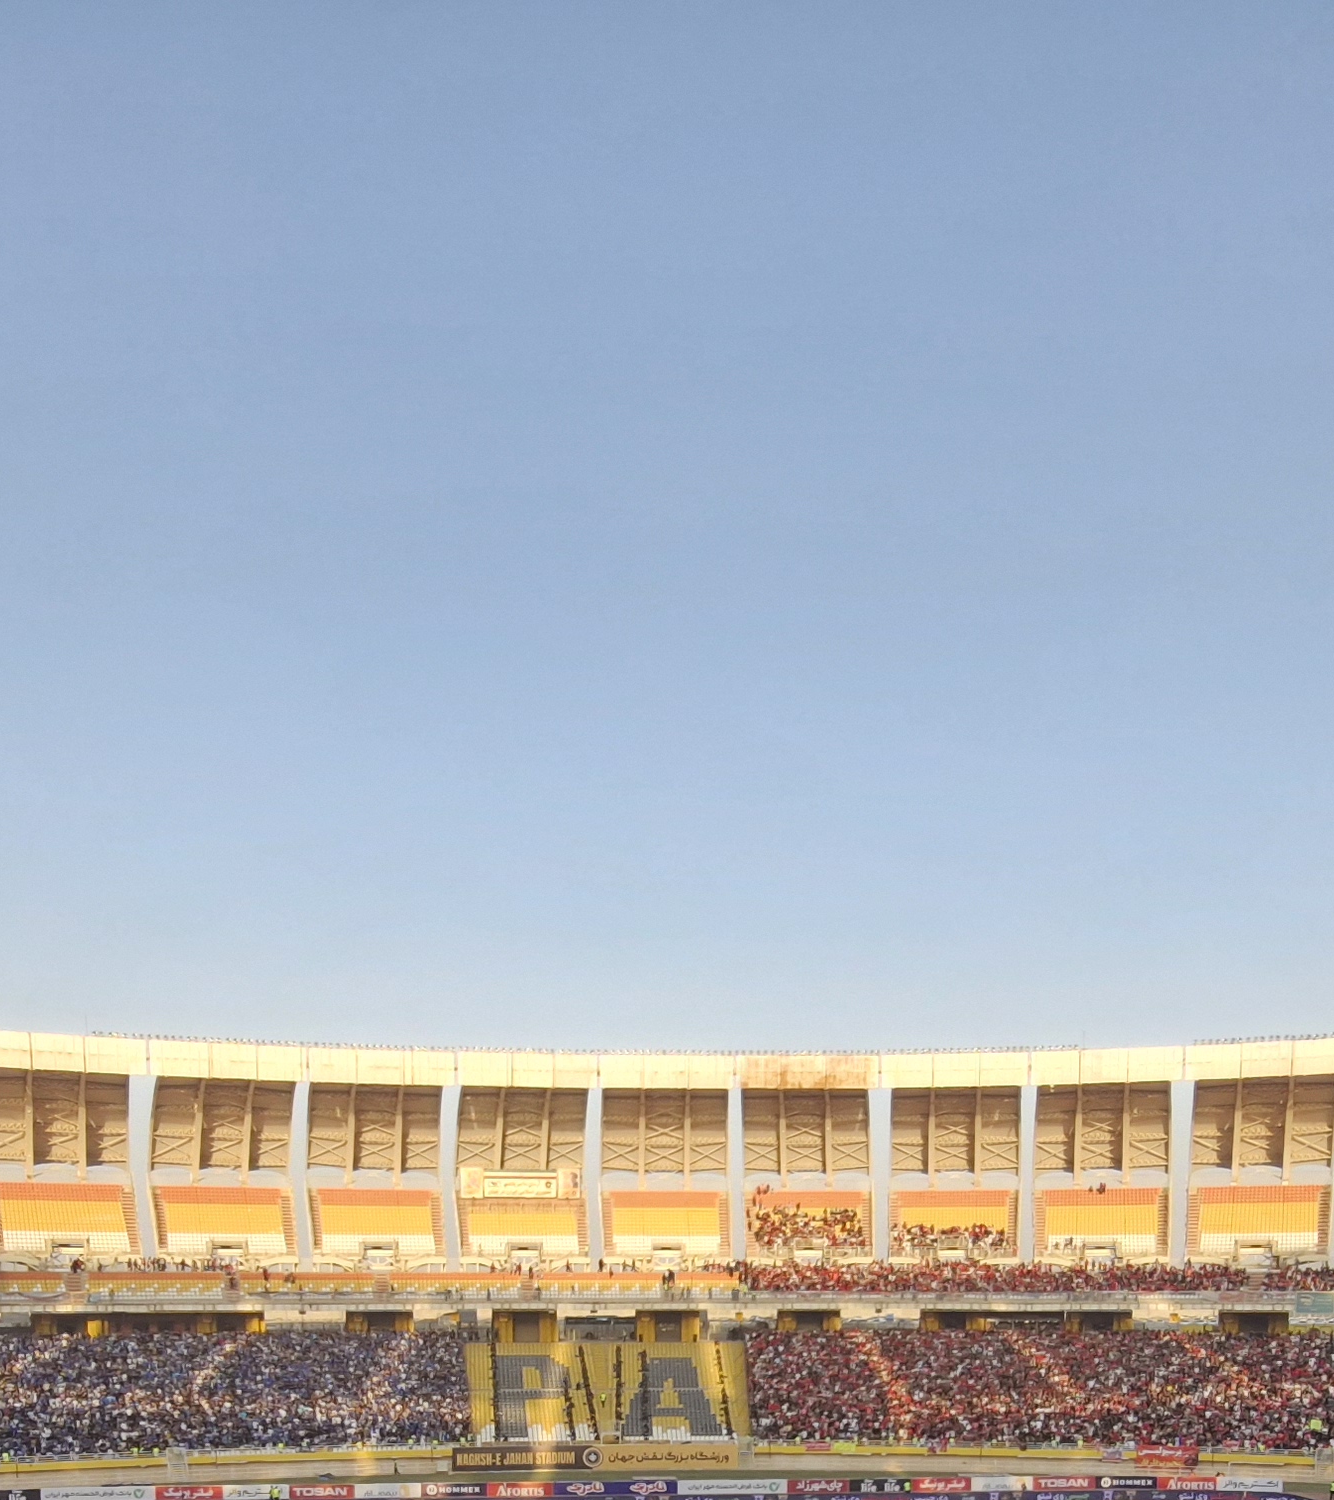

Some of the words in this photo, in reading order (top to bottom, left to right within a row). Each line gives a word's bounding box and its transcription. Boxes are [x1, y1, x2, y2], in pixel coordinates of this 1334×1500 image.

[456, 1452, 502, 1466] NAGHSH-E
[503, 1451, 534, 1465] JAHAN
[534, 1451, 576, 1465] STADIUM
[608, 1452, 638, 1464] جهان
[638, 1452, 665, 1463] نقش
[666, 1451, 690, 1464] بزرگ
[690, 1452, 730, 1464] ورزشگاه
[566, 1481, 605, 1496] نادری
[629, 1480, 668, 1495] نادری
[1038, 1478, 1090, 1488] TOSAN
[294, 1487, 349, 1497] TOSAN
